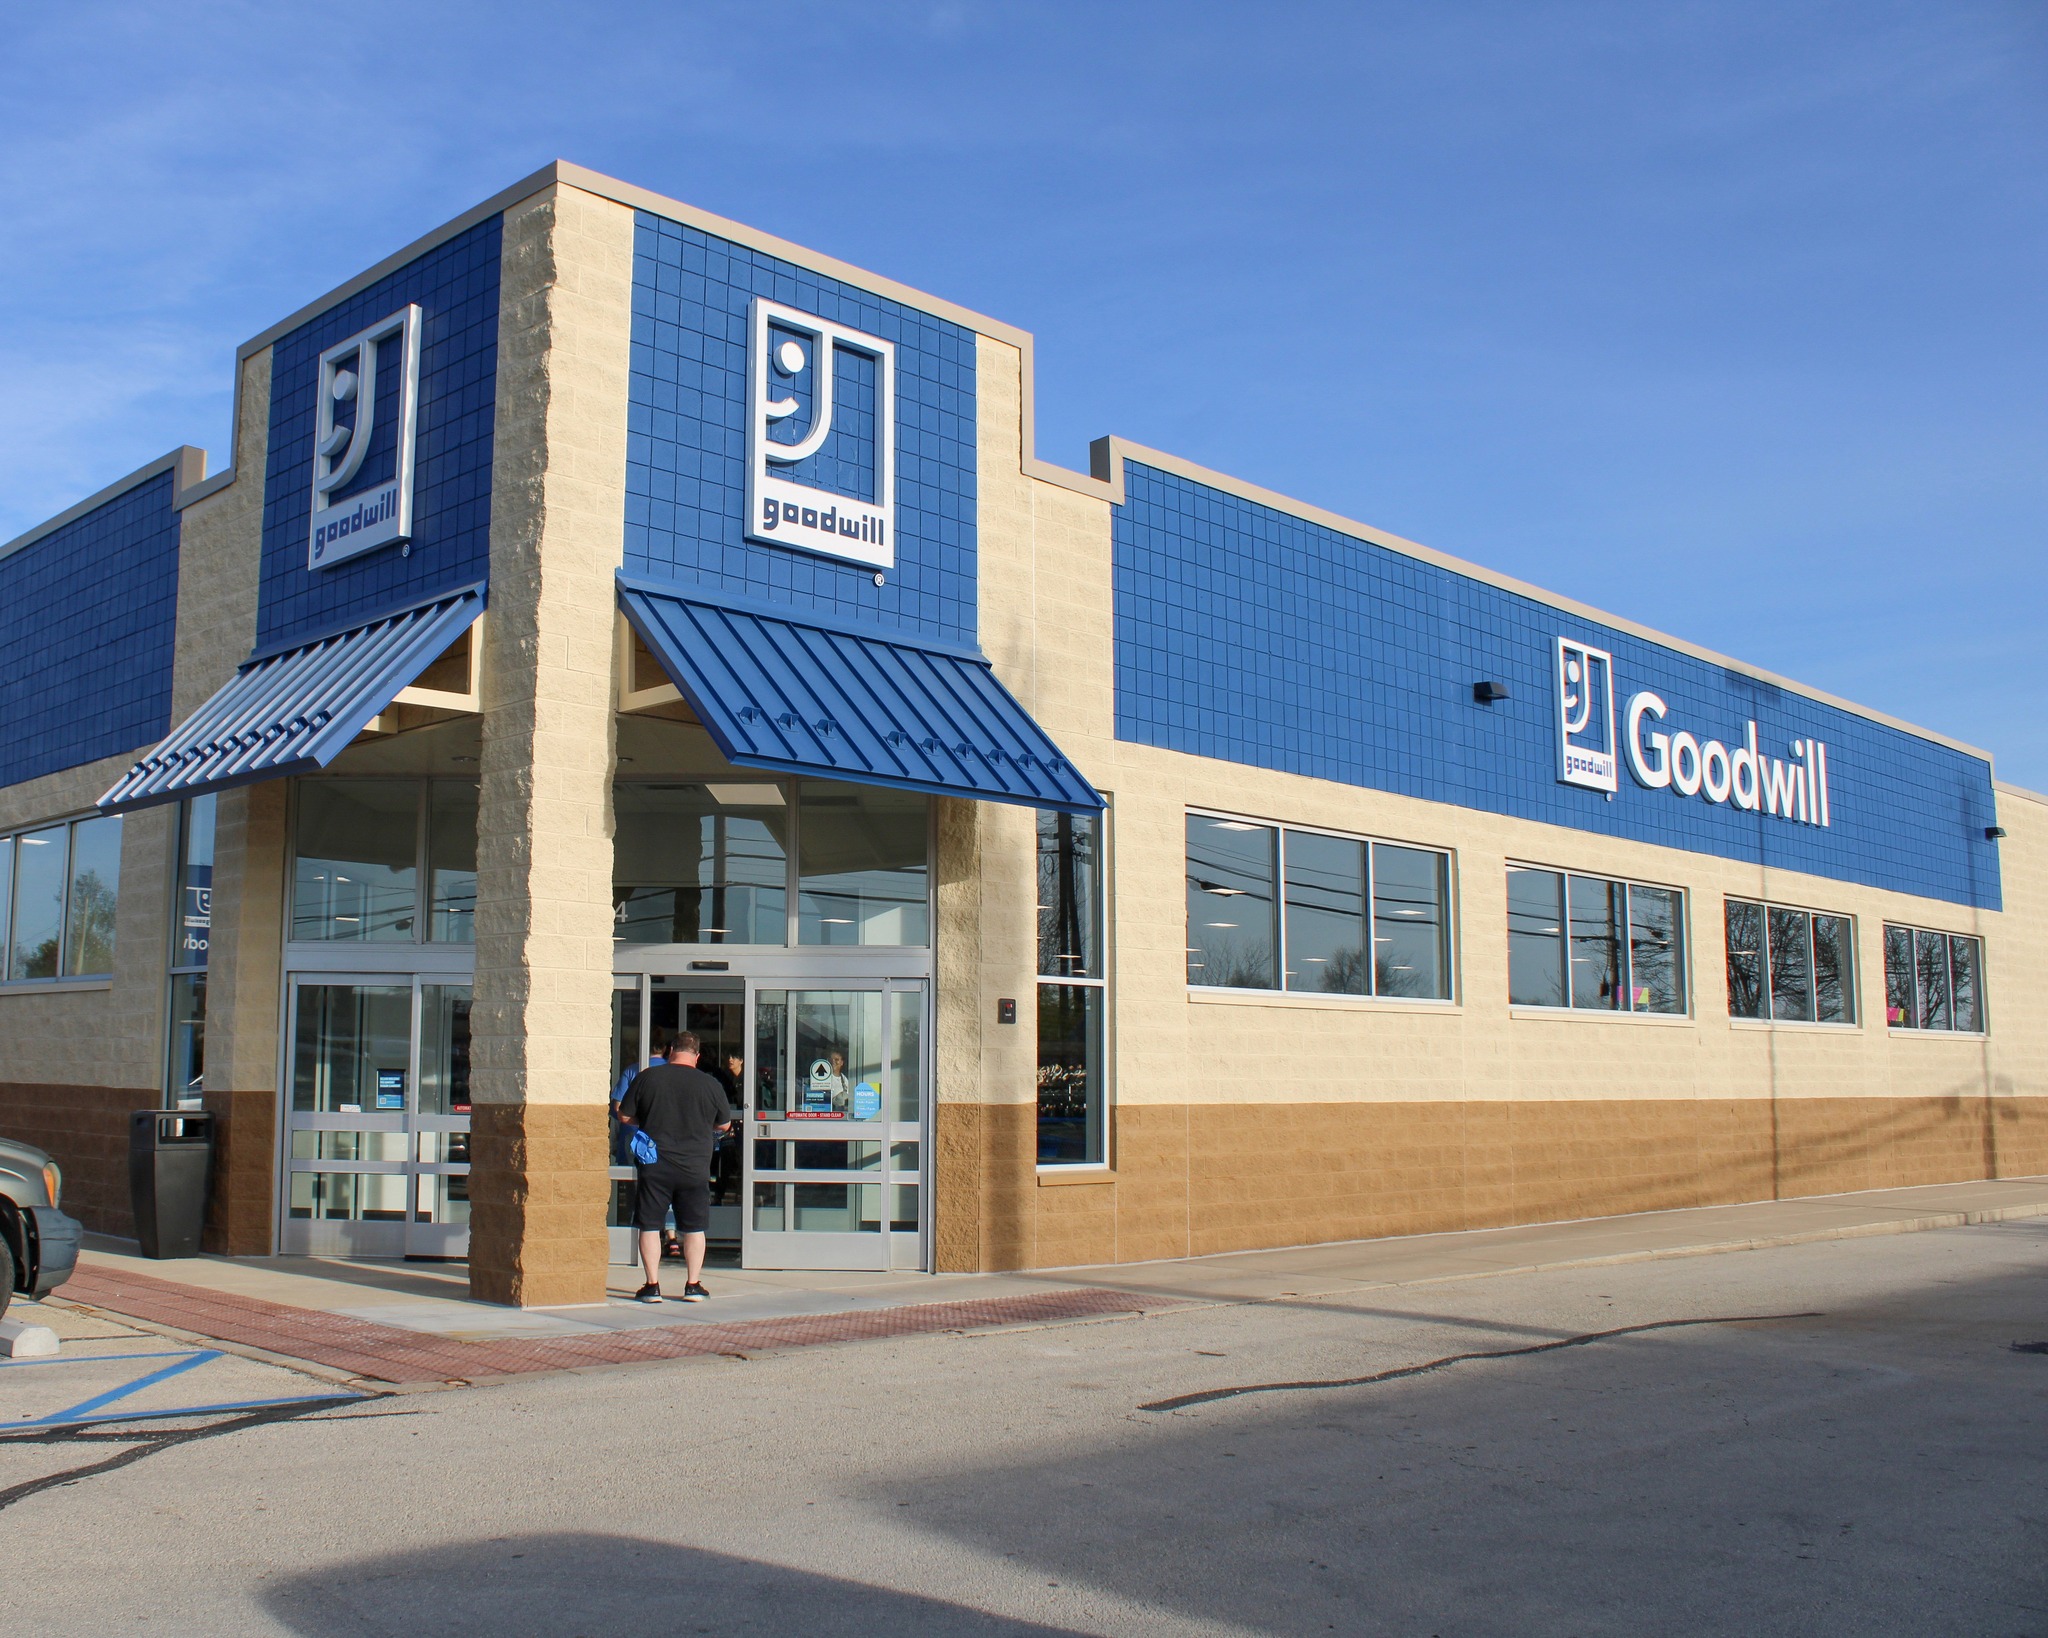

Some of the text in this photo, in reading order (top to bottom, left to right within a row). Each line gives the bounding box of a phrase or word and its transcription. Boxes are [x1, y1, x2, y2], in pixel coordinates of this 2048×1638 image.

[314, 488, 397, 560] goodwill
[763, 497, 884, 546] goodwill
[1566, 756, 1612, 778] goodwill
[1624, 691, 1830, 827] Goodwill
